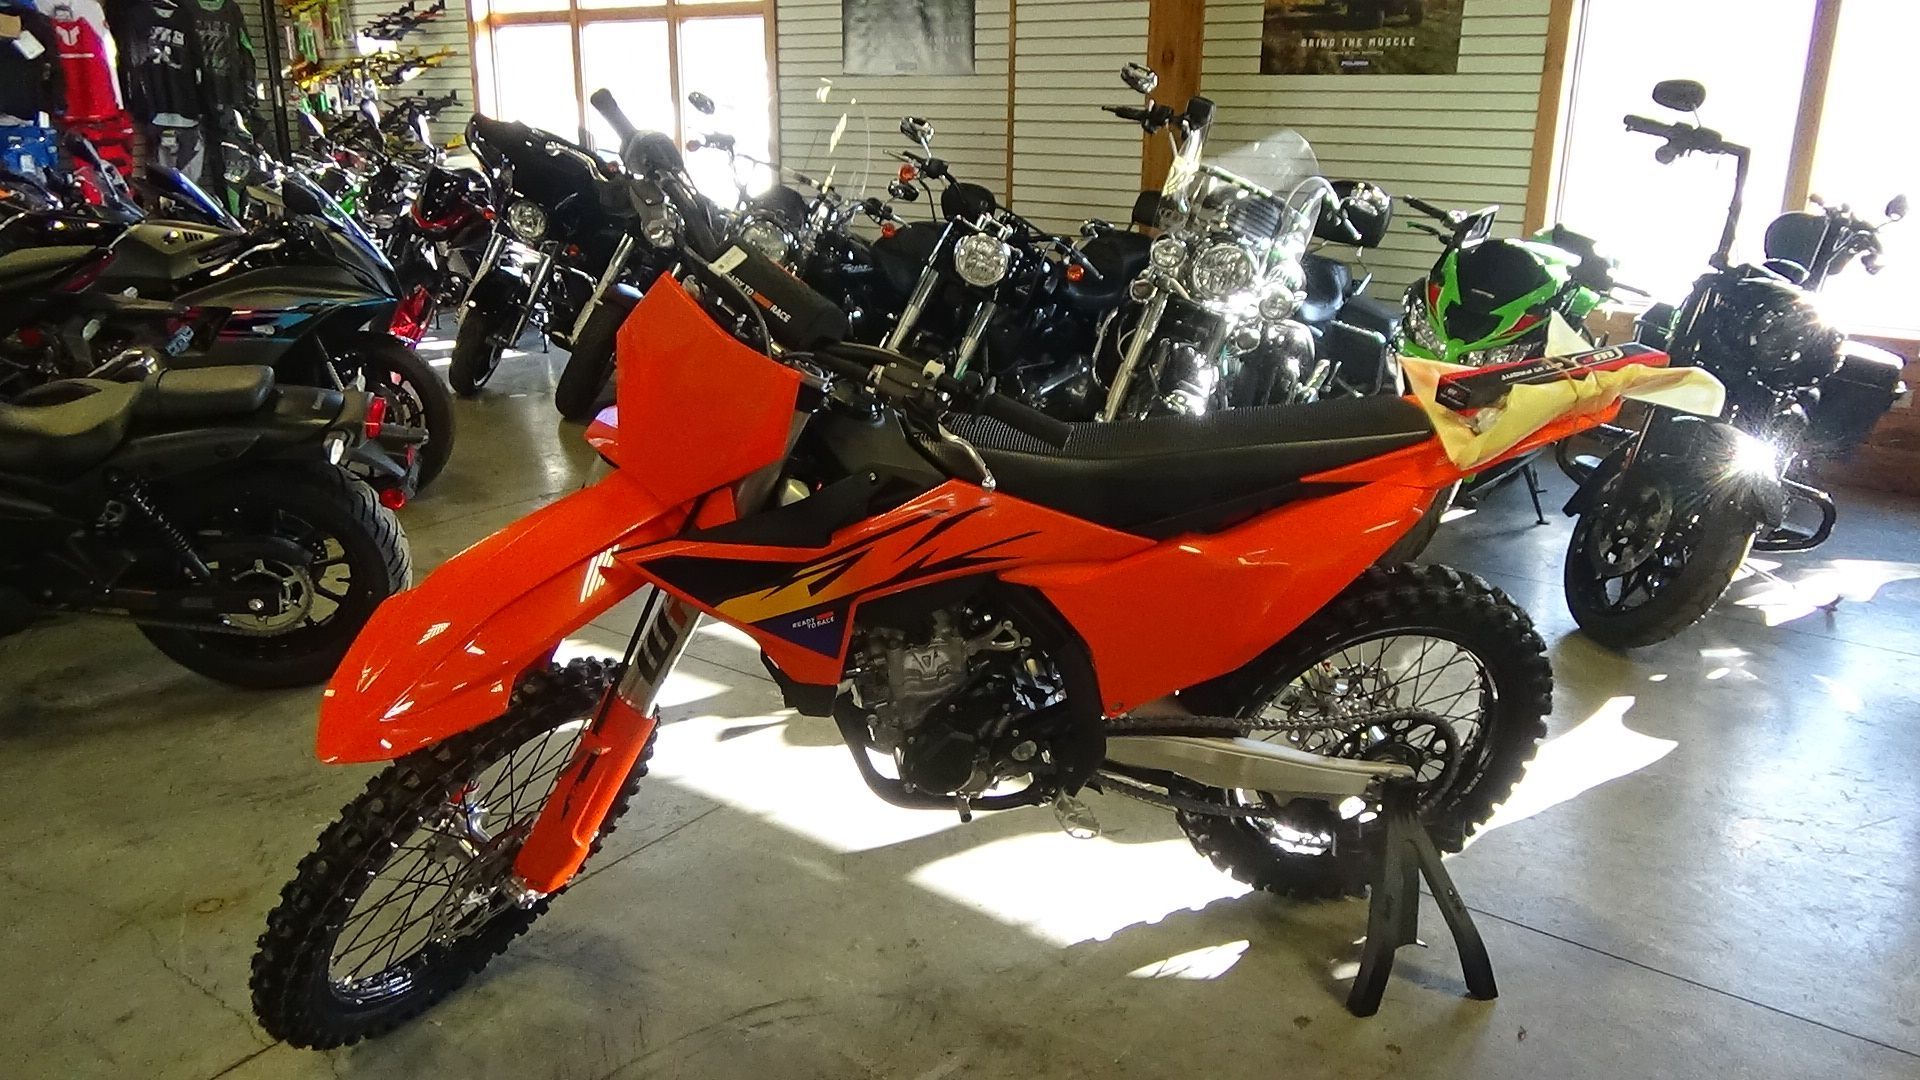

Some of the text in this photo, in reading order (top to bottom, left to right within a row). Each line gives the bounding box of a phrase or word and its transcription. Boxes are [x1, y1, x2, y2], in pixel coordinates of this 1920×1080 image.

[1341, 37, 1363, 47] THE
[1368, 36, 1416, 47] MUSCLE
[769, 304, 792, 324] RACE
[792, 617, 815, 629] READY
[817, 615, 834, 627] RACE
